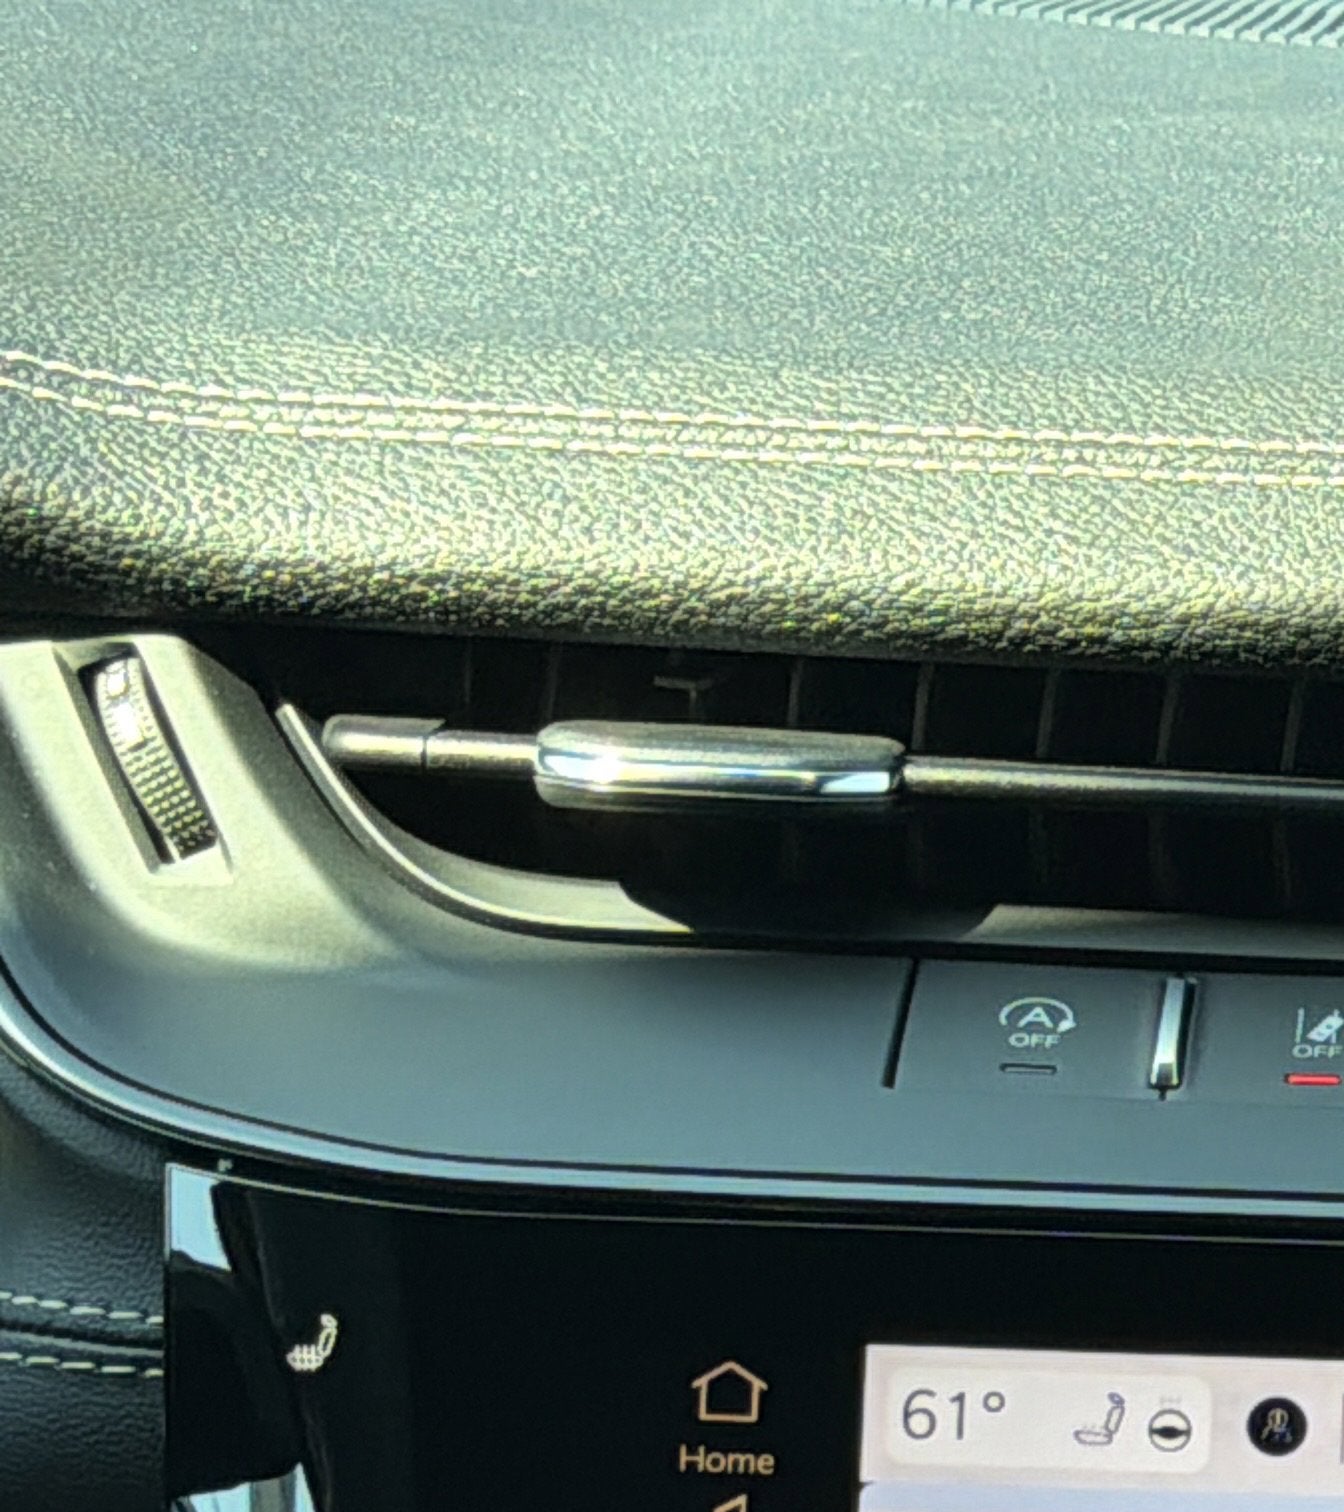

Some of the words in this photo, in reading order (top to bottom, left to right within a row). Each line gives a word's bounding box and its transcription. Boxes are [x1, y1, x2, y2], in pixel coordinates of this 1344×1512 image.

[1009, 1032, 1060, 1048] OFF
[1293, 1044, 1344, 1059] OFF
[901, 1389, 1006, 1441] 61°
[679, 1445, 775, 1475] Home
